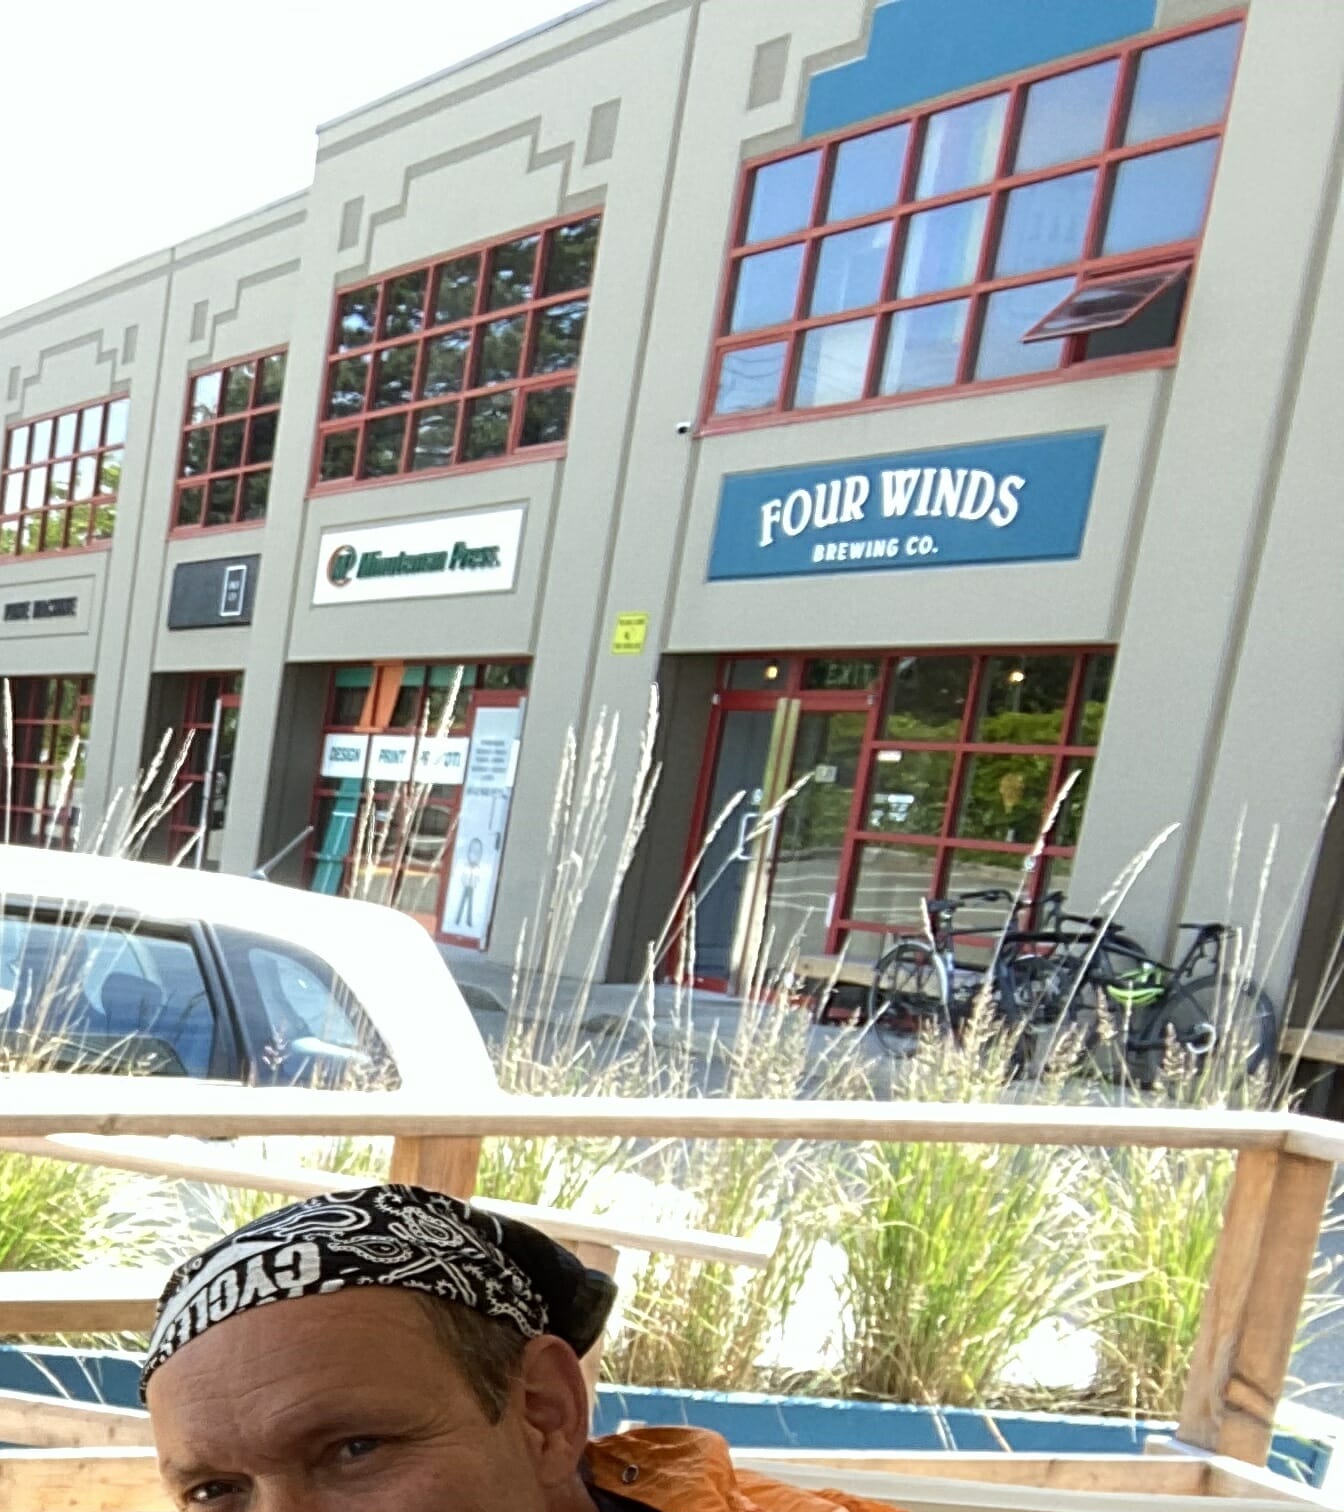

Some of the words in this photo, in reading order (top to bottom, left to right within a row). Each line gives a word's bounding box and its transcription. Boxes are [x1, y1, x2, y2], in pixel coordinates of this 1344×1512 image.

[759, 474, 869, 548] FOUR
[880, 467, 1026, 528] WINDS
[812, 536, 899, 563] BREWING
[905, 534, 939, 556] CO.
